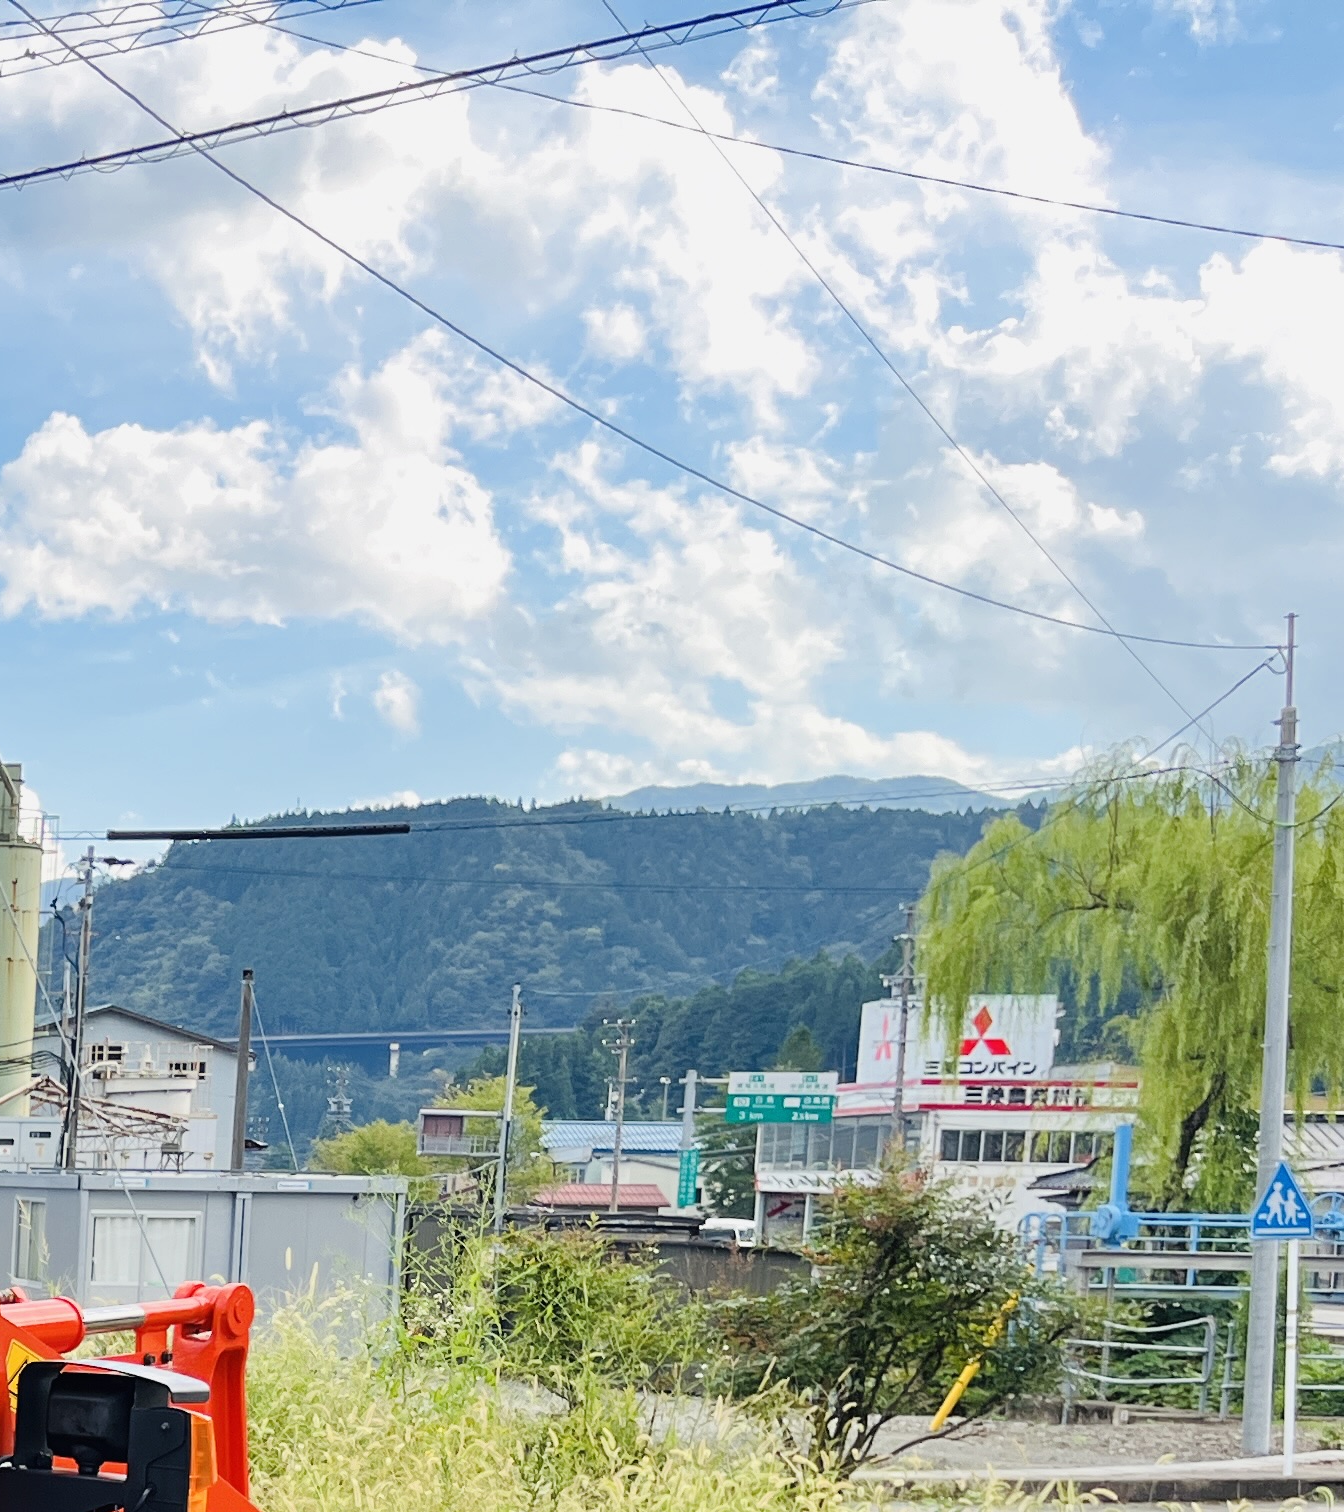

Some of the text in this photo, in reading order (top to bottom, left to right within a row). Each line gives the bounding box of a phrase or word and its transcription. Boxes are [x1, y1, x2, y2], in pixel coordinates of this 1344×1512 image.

[924, 1060, 1037, 1076] 三コンバイン
